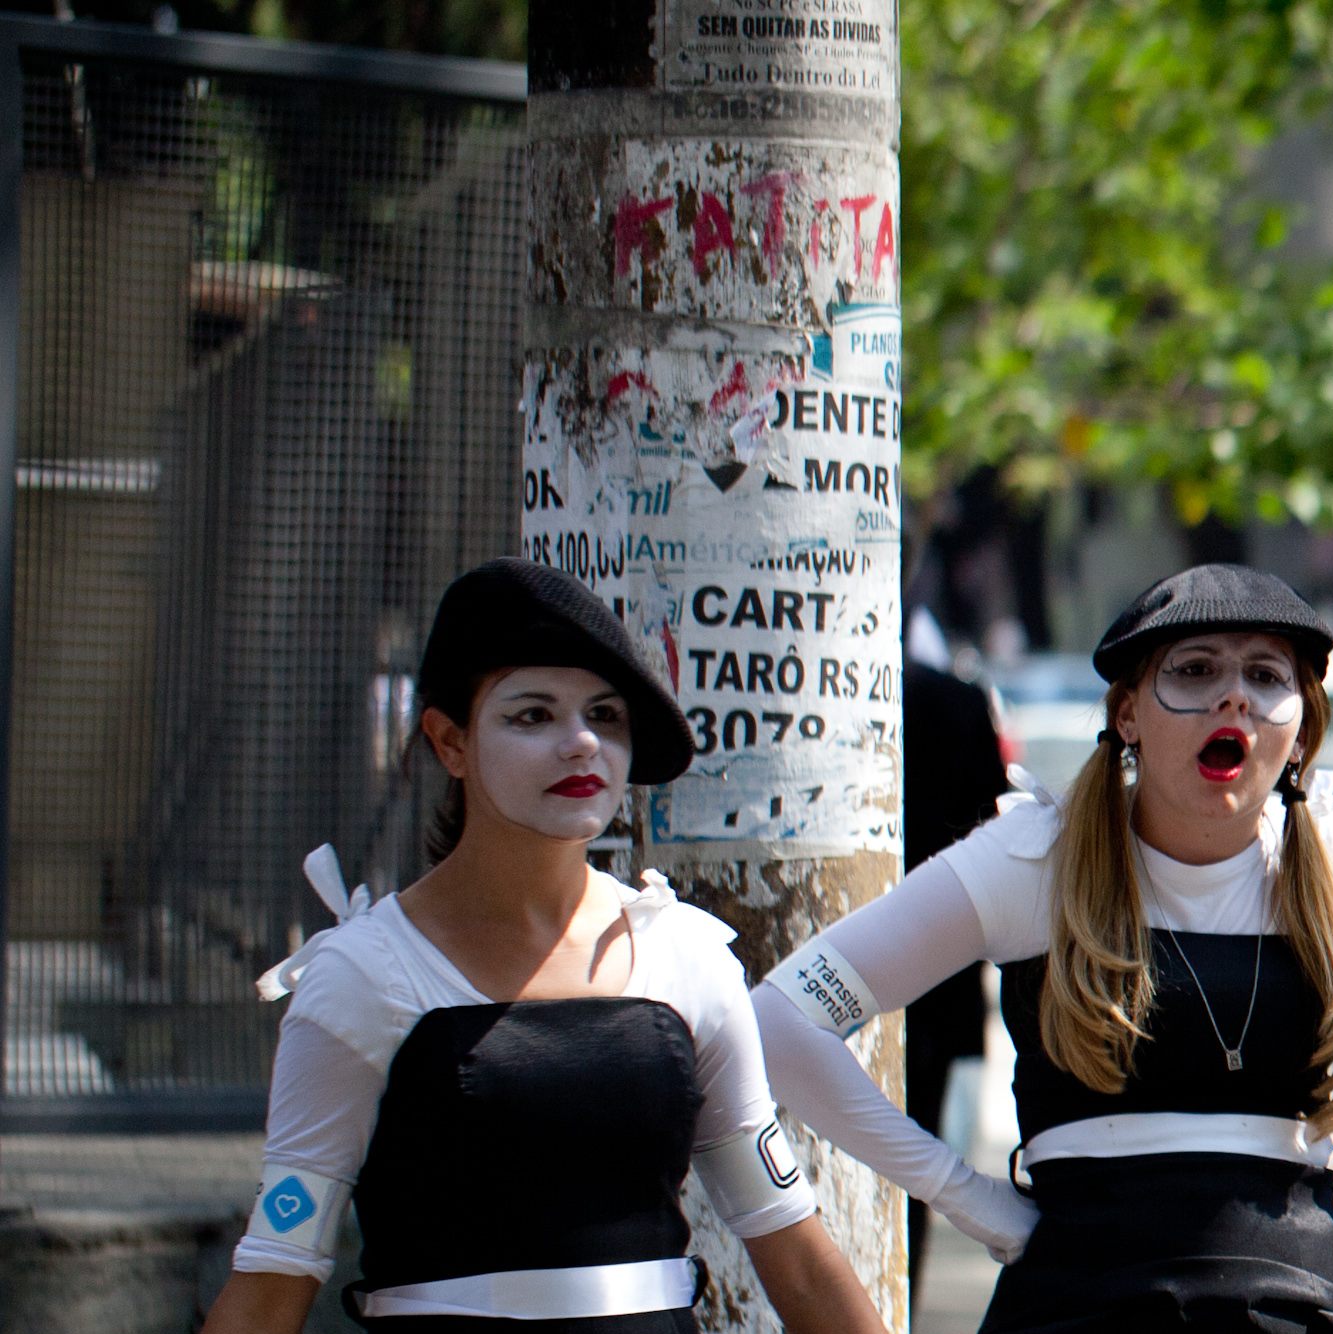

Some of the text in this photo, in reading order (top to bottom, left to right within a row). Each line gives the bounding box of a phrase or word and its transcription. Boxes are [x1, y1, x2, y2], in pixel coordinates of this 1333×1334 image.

[698, 15, 881, 44] SEM QUITAR AS DÍVIDAS
[702, 62, 880, 89] Tudo Dentro da Lei
[851, 331, 897, 355] PLANOS
[689, 643, 805, 695] TARÔ
[819, 658, 860, 700] R$
[811, 954, 863, 1020] Trânsito
